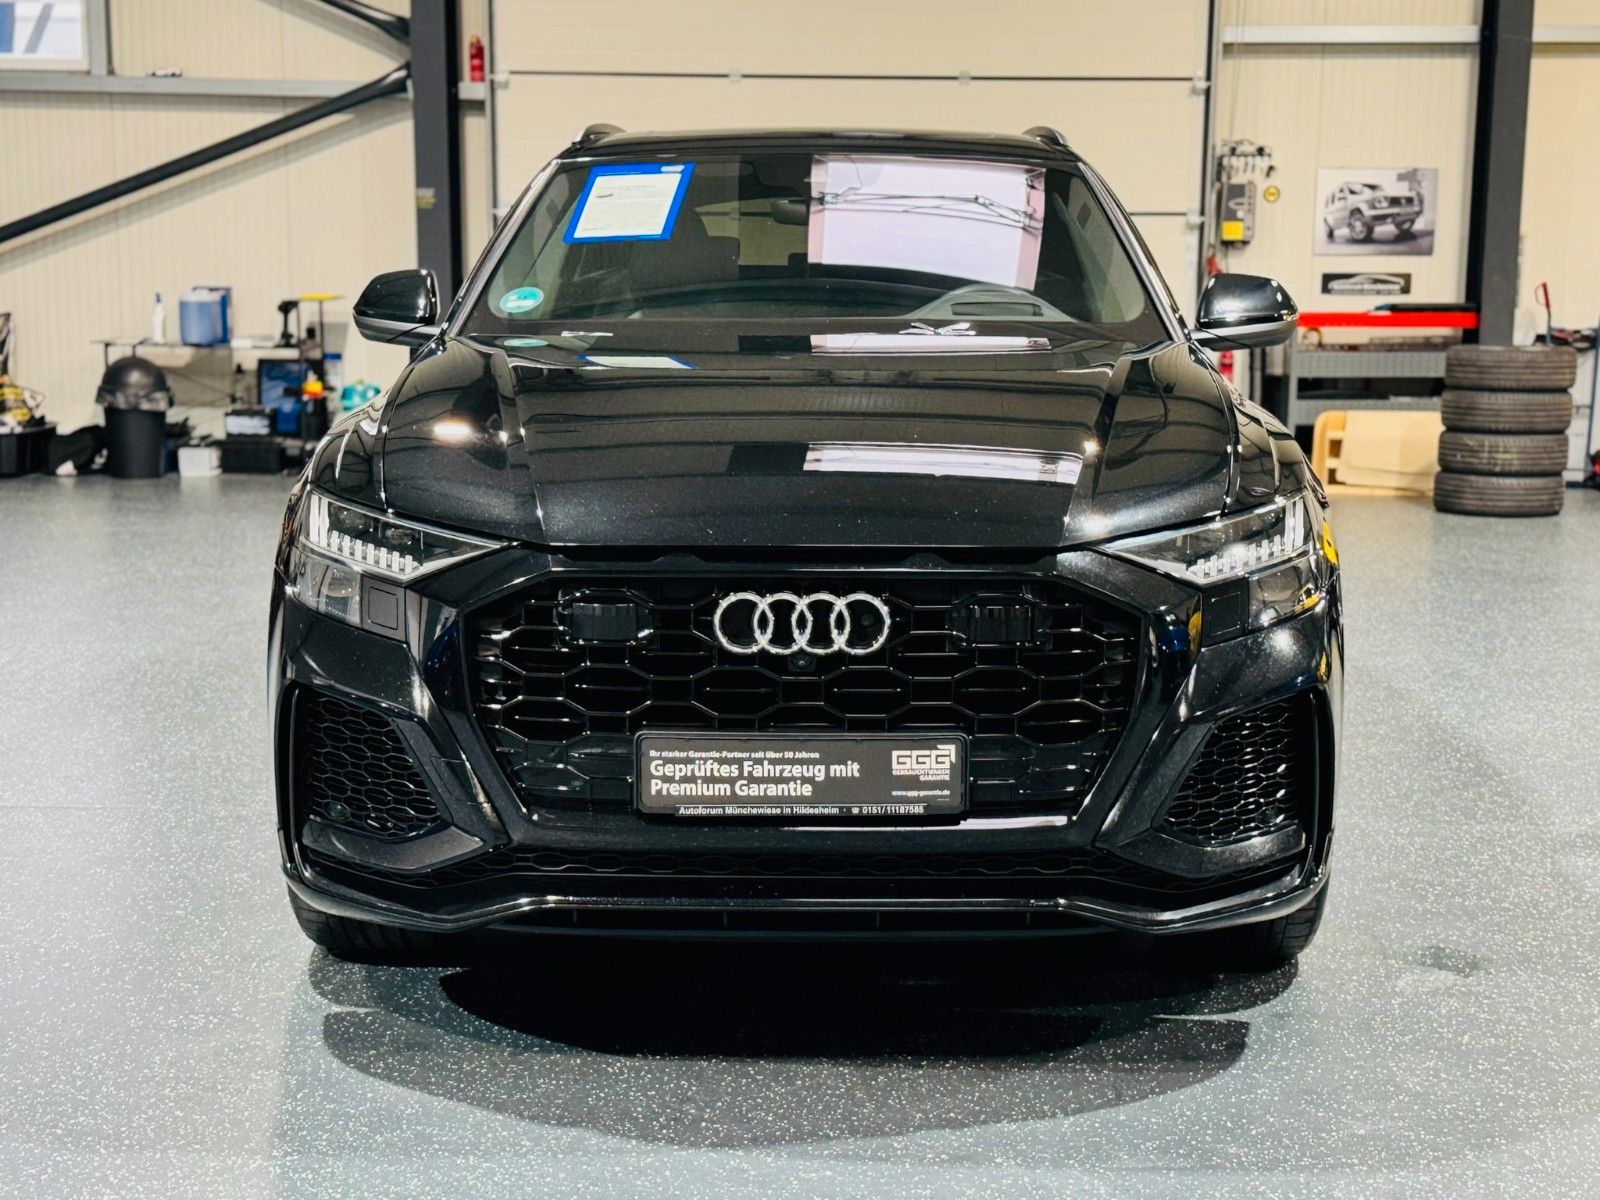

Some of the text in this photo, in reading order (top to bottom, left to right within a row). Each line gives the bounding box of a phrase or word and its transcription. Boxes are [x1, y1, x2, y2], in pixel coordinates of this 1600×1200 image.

[649, 750, 660, 758] Ihr
[661, 750, 687, 758] starker
[751, 750, 765, 758] seit
[765, 750, 783, 758] über
[794, 750, 820, 758] Jahren
[892, 750, 950, 769] GGG
[650, 760, 861, 782] Geprüftes Fahrzeug mit
[650, 779, 813, 796] Premium Garantie
[678, 806, 723, 815] Autoforum
[725, 806, 781, 815] Münchewiese
[783, 806, 791, 814] in
[793, 806, 839, 814] Hildesheim
